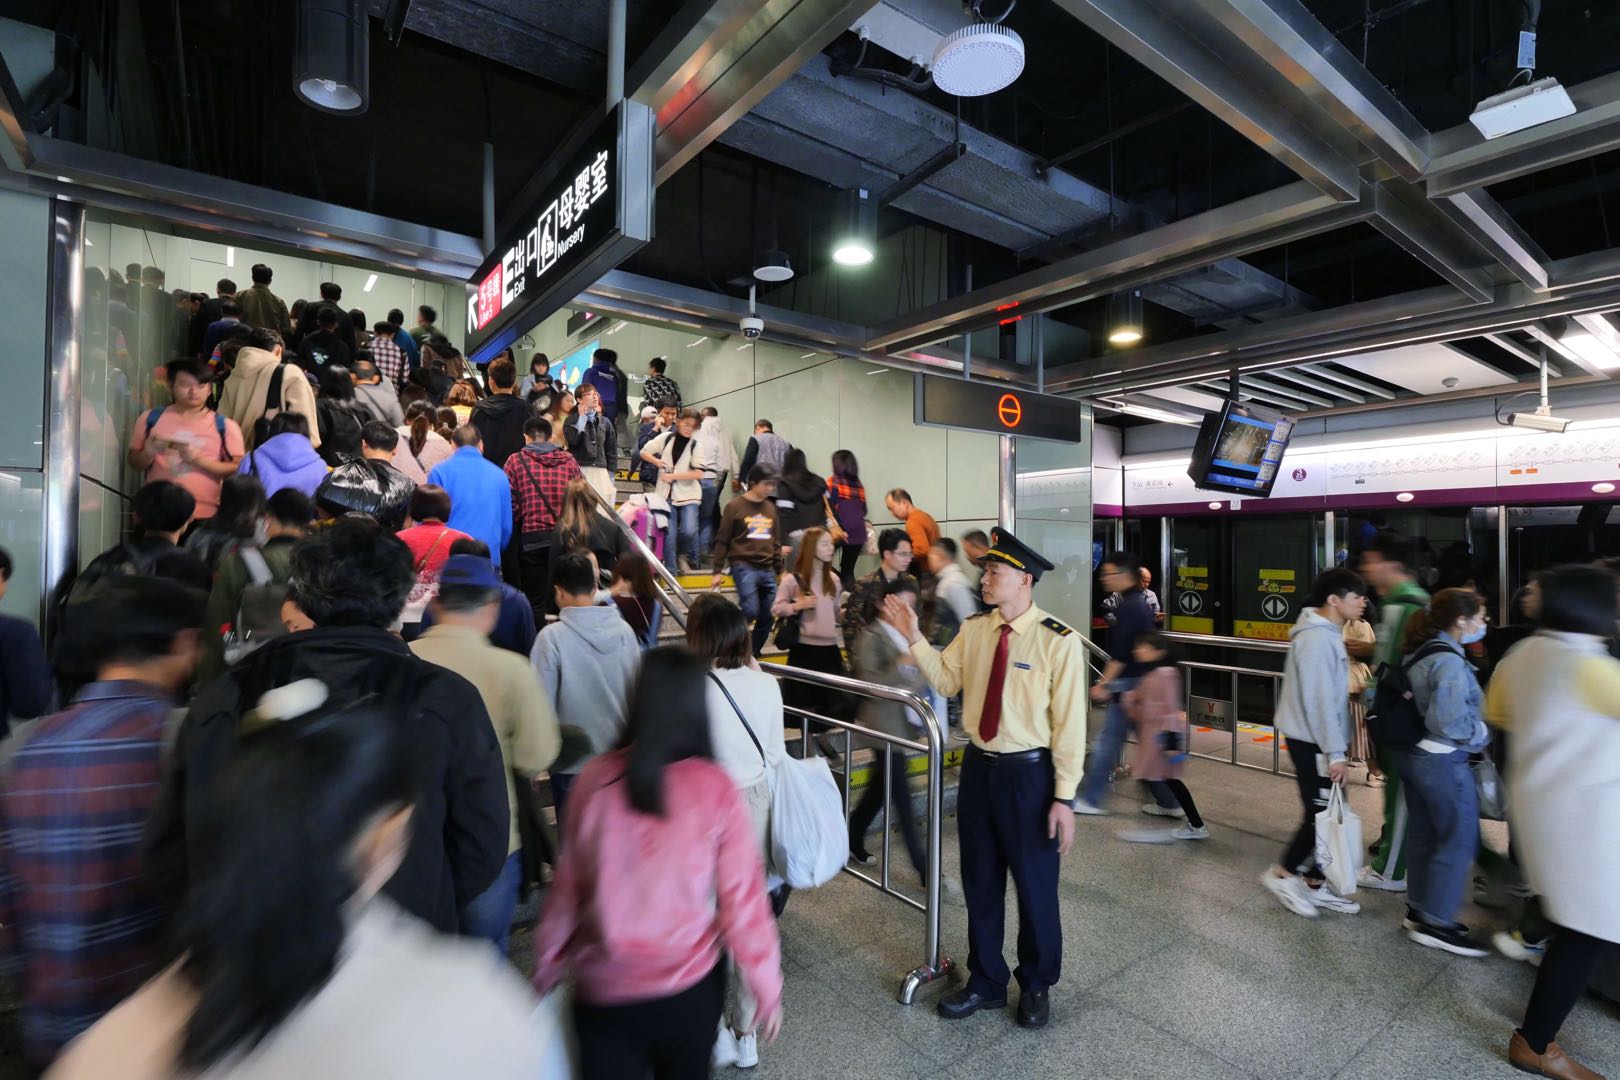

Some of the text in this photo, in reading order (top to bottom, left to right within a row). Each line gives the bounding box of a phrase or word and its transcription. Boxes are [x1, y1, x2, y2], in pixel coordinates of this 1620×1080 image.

[559, 150, 608, 230] 母婴室
[558, 223, 585, 258] Nursery
[502, 226, 537, 310] E 出口
[481, 272, 500, 310] 5号线
[514, 275, 526, 298] Exit
[480, 310, 489, 326] Line
